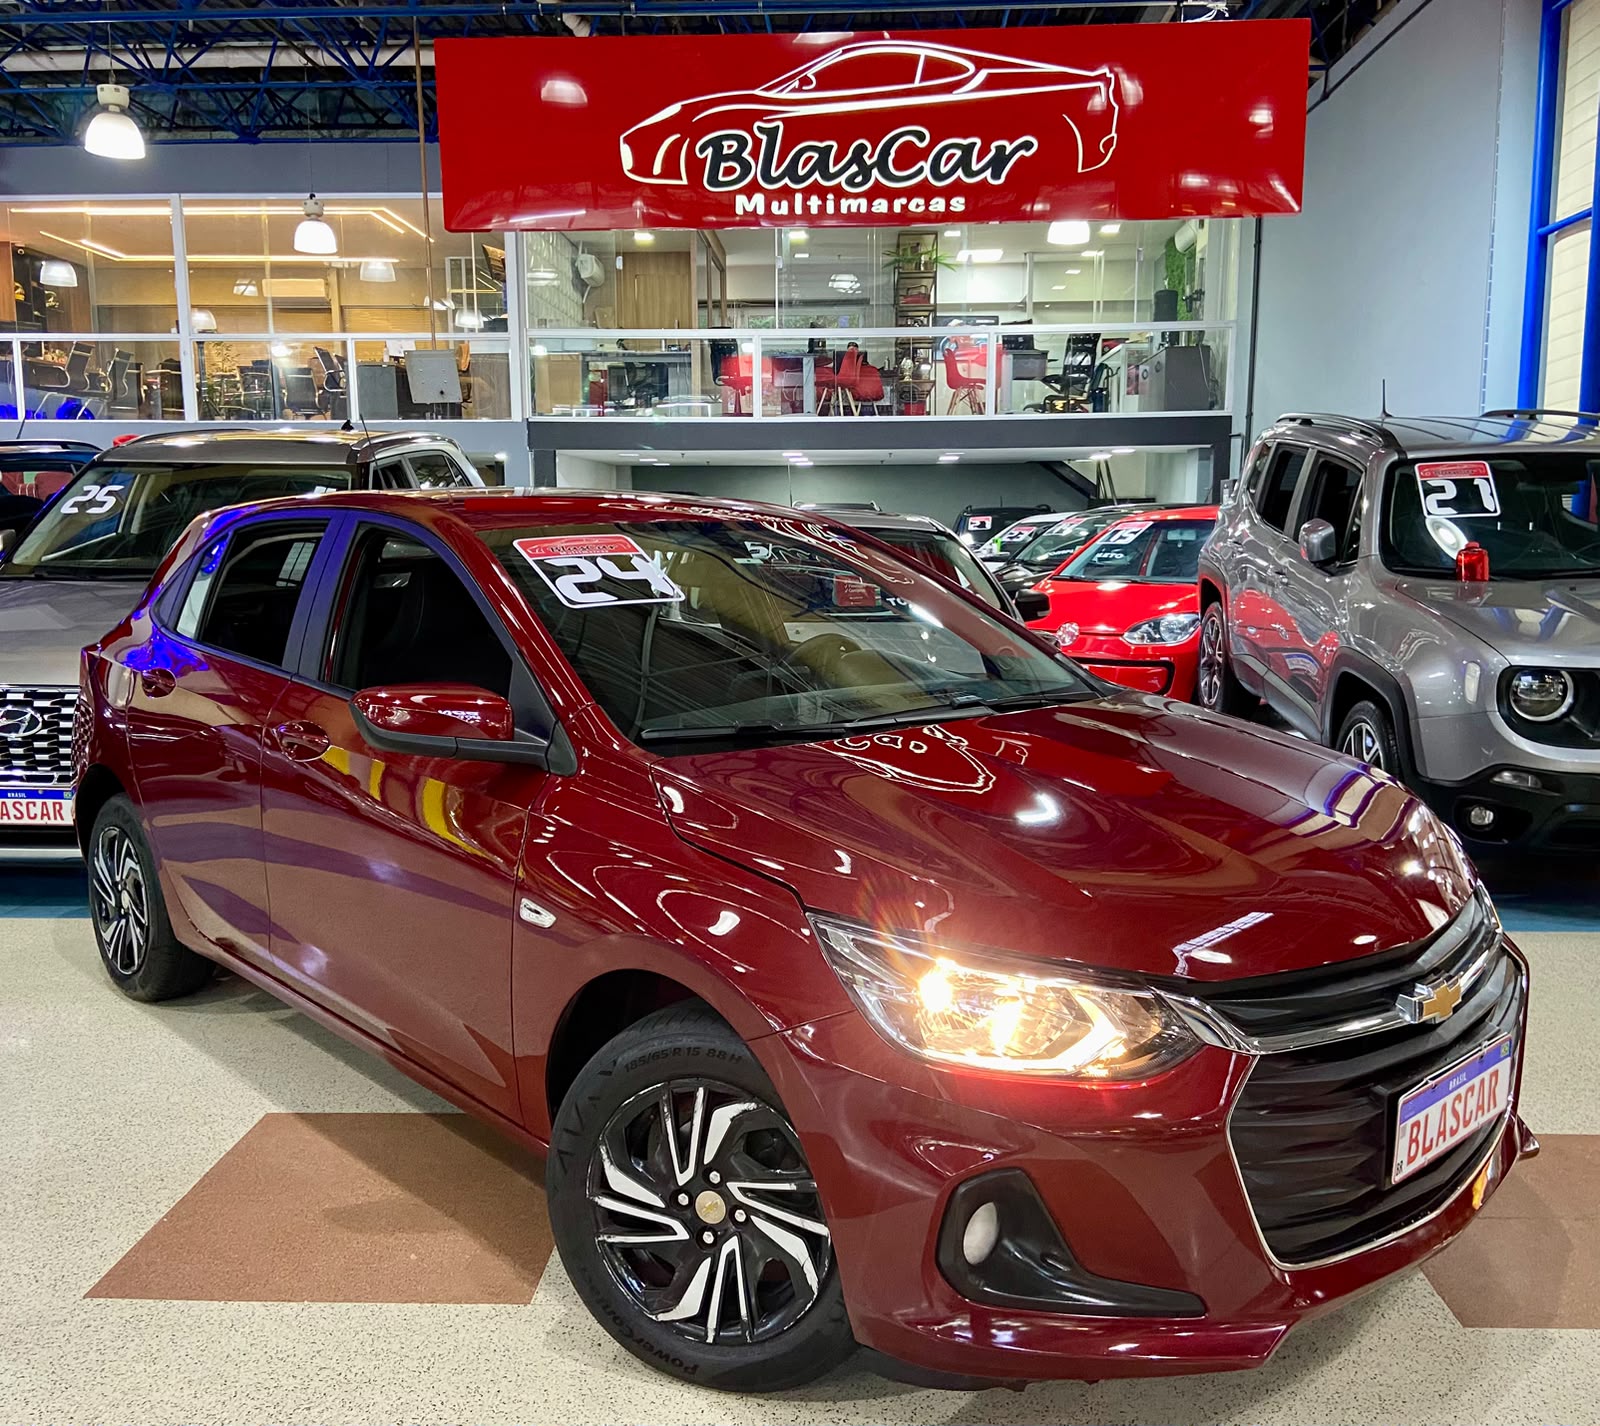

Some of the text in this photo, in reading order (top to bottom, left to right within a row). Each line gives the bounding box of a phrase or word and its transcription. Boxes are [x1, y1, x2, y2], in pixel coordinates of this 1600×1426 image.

[696, 121, 1038, 192] BlasCar
[735, 193, 966, 216] Multimarcas
[60, 484, 125, 514] 25
[1426, 478, 1496, 515] 21
[544, 556, 676, 603] 24
[624, 1047, 669, 1074] 185/65
[686, 1046, 701, 1057] 15
[705, 1048, 725, 1060] 88
[1406, 1069, 1500, 1166] BLASCAR
